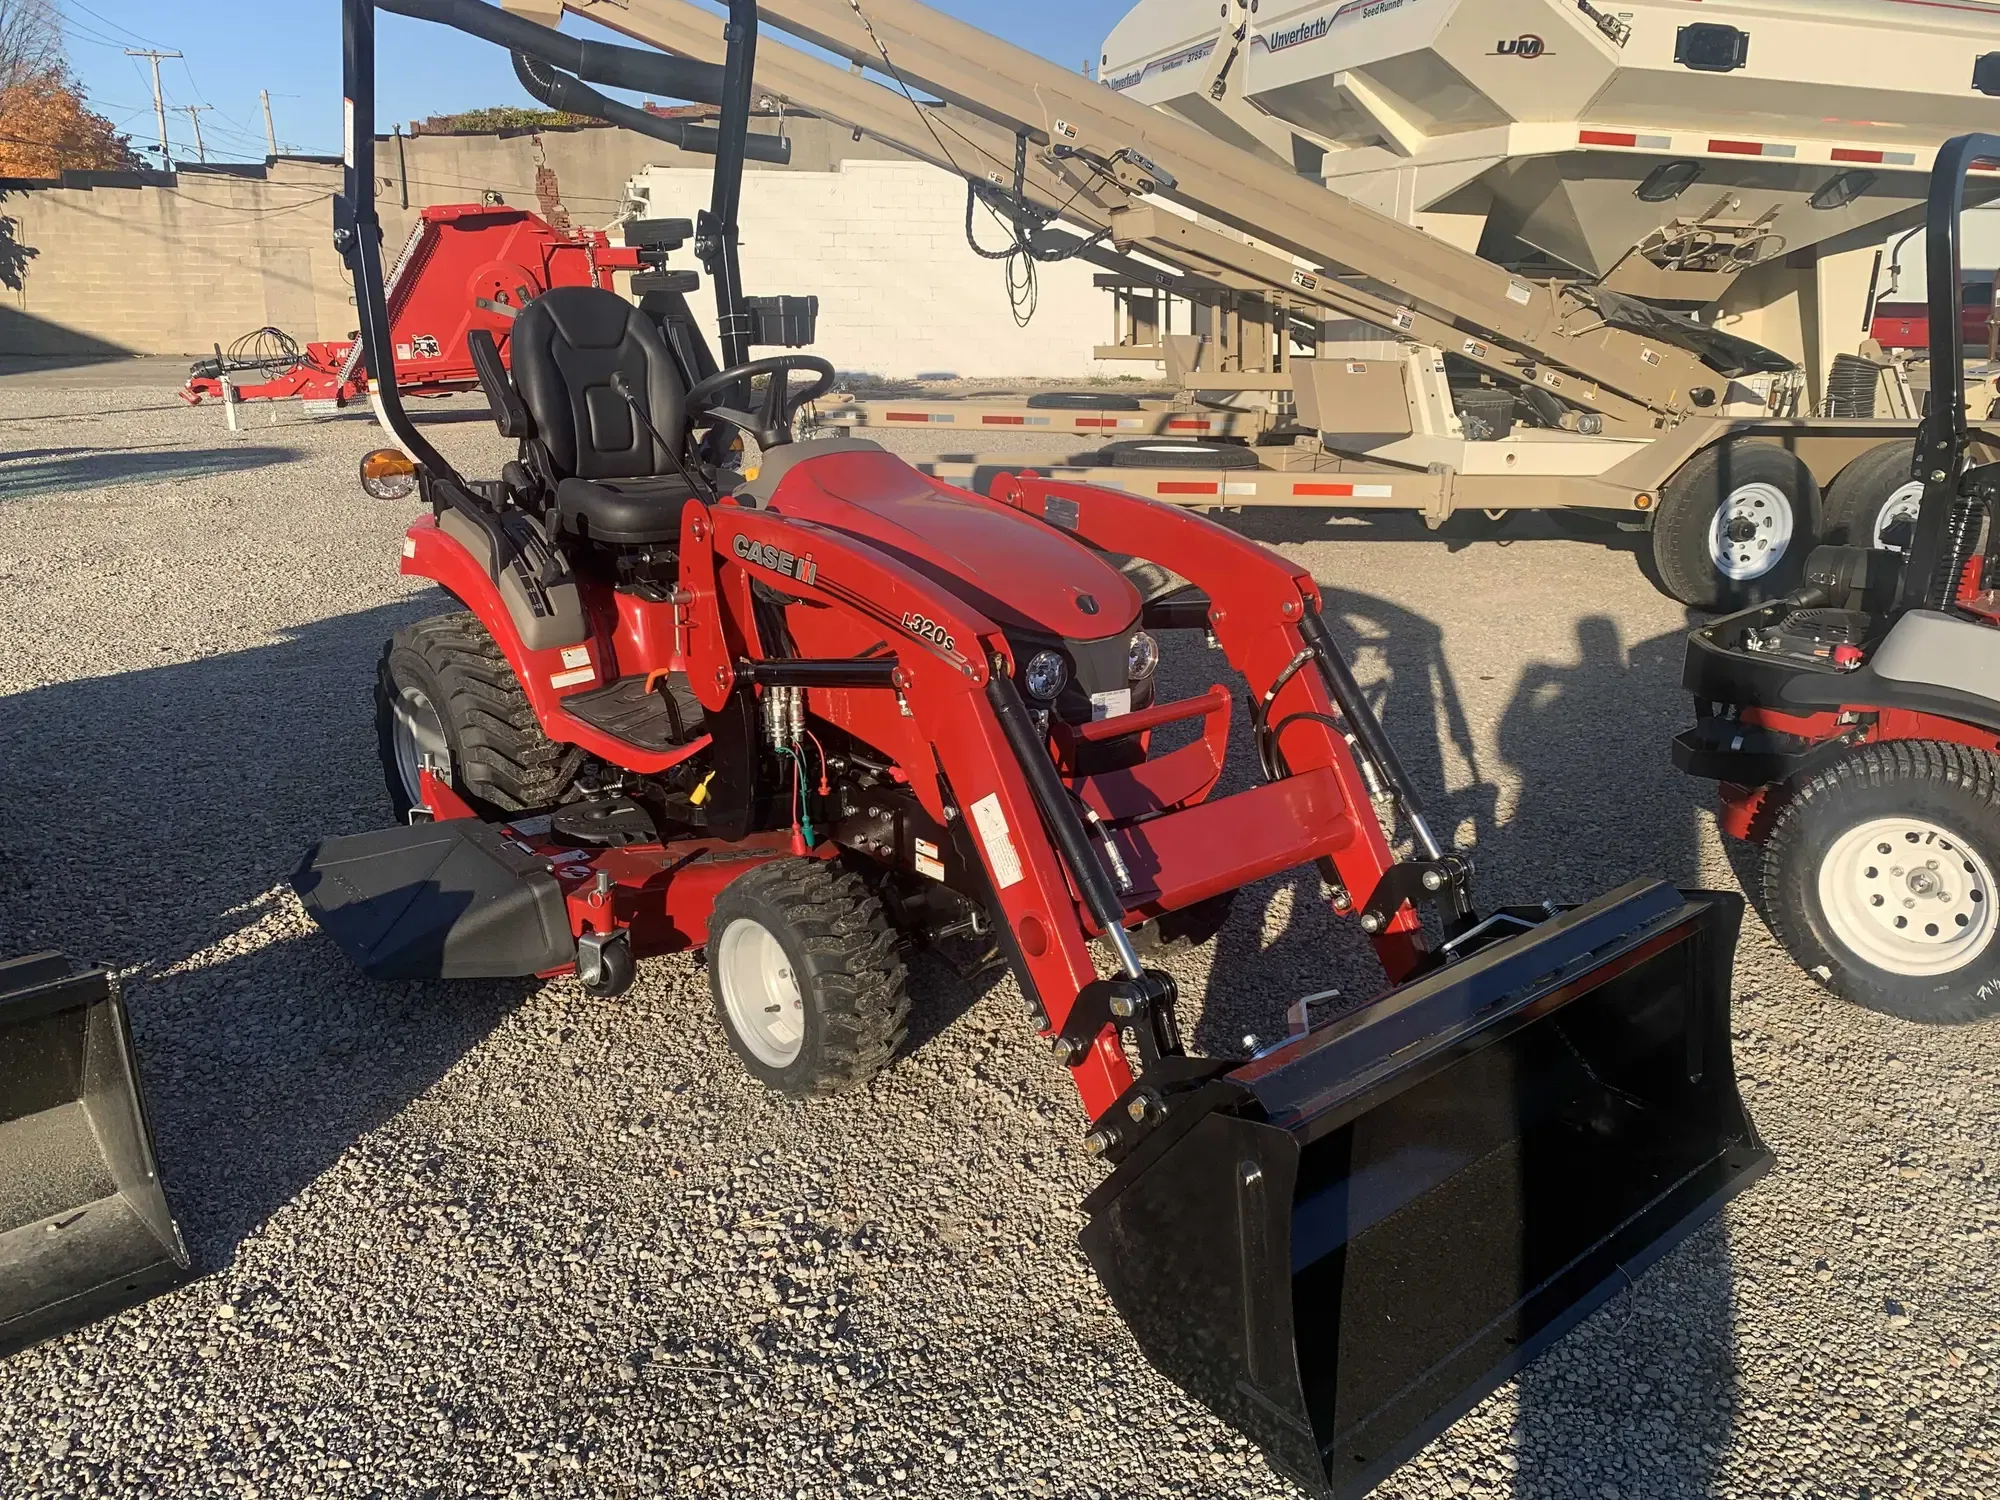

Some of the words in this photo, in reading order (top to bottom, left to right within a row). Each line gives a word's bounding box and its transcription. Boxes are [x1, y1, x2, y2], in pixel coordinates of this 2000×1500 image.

[1363, 4, 1380, 19] Seed
[1380, 0, 1404, 13] Runner
[1270, 16, 1327, 50] Unverferth
[1497, 40, 1540, 53] UM
[1111, 70, 1141, 90] Unverferth
[732, 533, 796, 577] CASE
